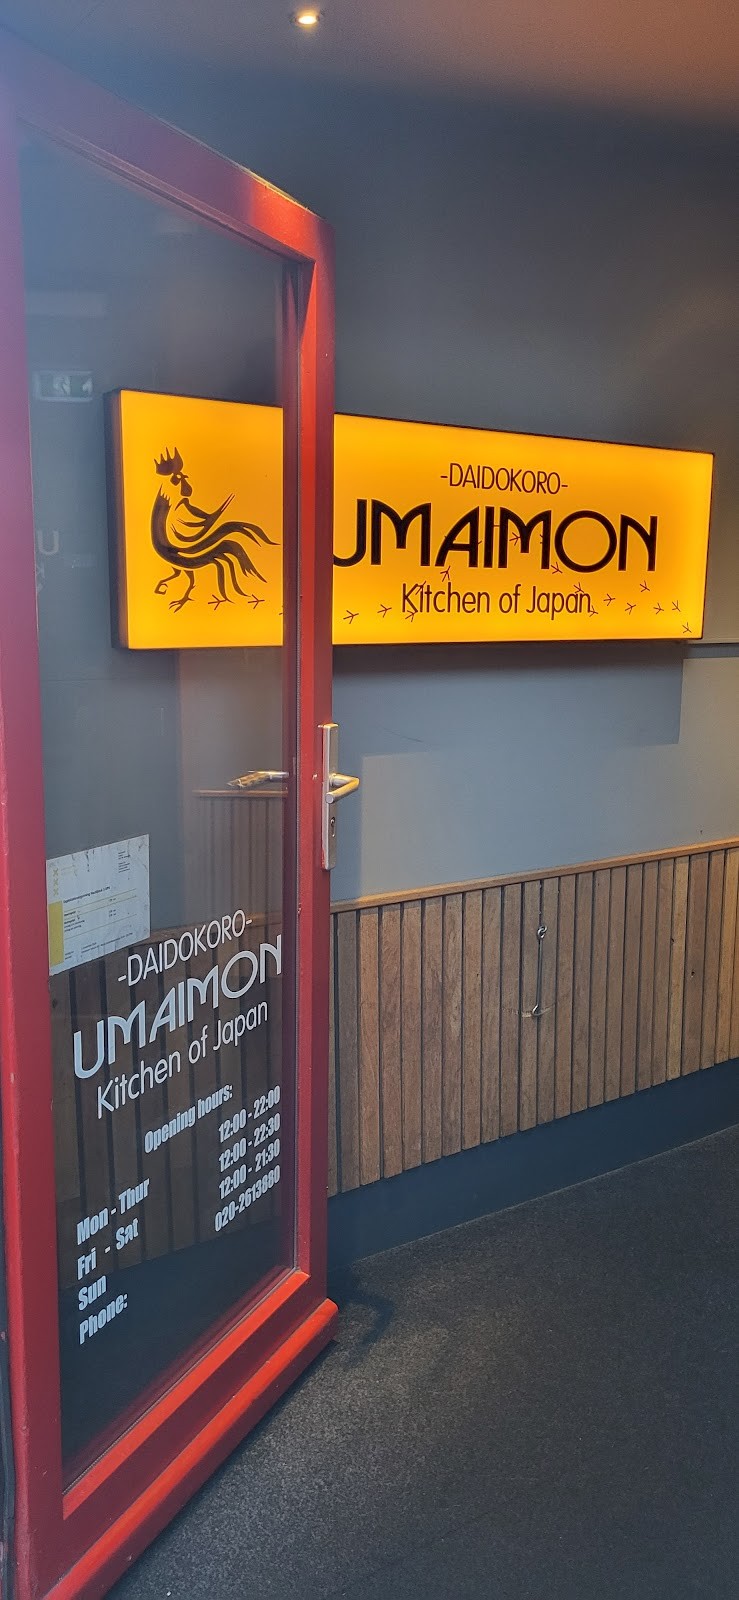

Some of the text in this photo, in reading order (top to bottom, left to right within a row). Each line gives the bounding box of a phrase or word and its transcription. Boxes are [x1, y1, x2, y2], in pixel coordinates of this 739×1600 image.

[440, 462, 568, 494] -DAIDOKORO-
[402, 582, 591, 620] Kitchen of Japan
[74, 934, 282, 1079] UMAIMON
[118, 909, 252, 986] -DAIDOKORO-
[98, 1002, 268, 1119] Kitchen of Japan
[144, 1084, 233, 1153] Opening hours:
[77, 1207, 109, 1245] Mon
[119, 1178, 150, 1214] Thur
[218, 1109, 246, 1143] 12:00
[253, 1085, 280, 1116] 22:00
[77, 1247, 96, 1280] Fri
[115, 1218, 139, 1250] Sat
[218, 1137, 247, 1172] 12:00
[253, 1113, 280, 1143] 22:30
[78, 1275, 107, 1311] Sun
[218, 1164, 247, 1200] 12:00
[254, 1138, 280, 1172] 21:30
[79, 1165, 280, 1345] Phone: 020-2613880
